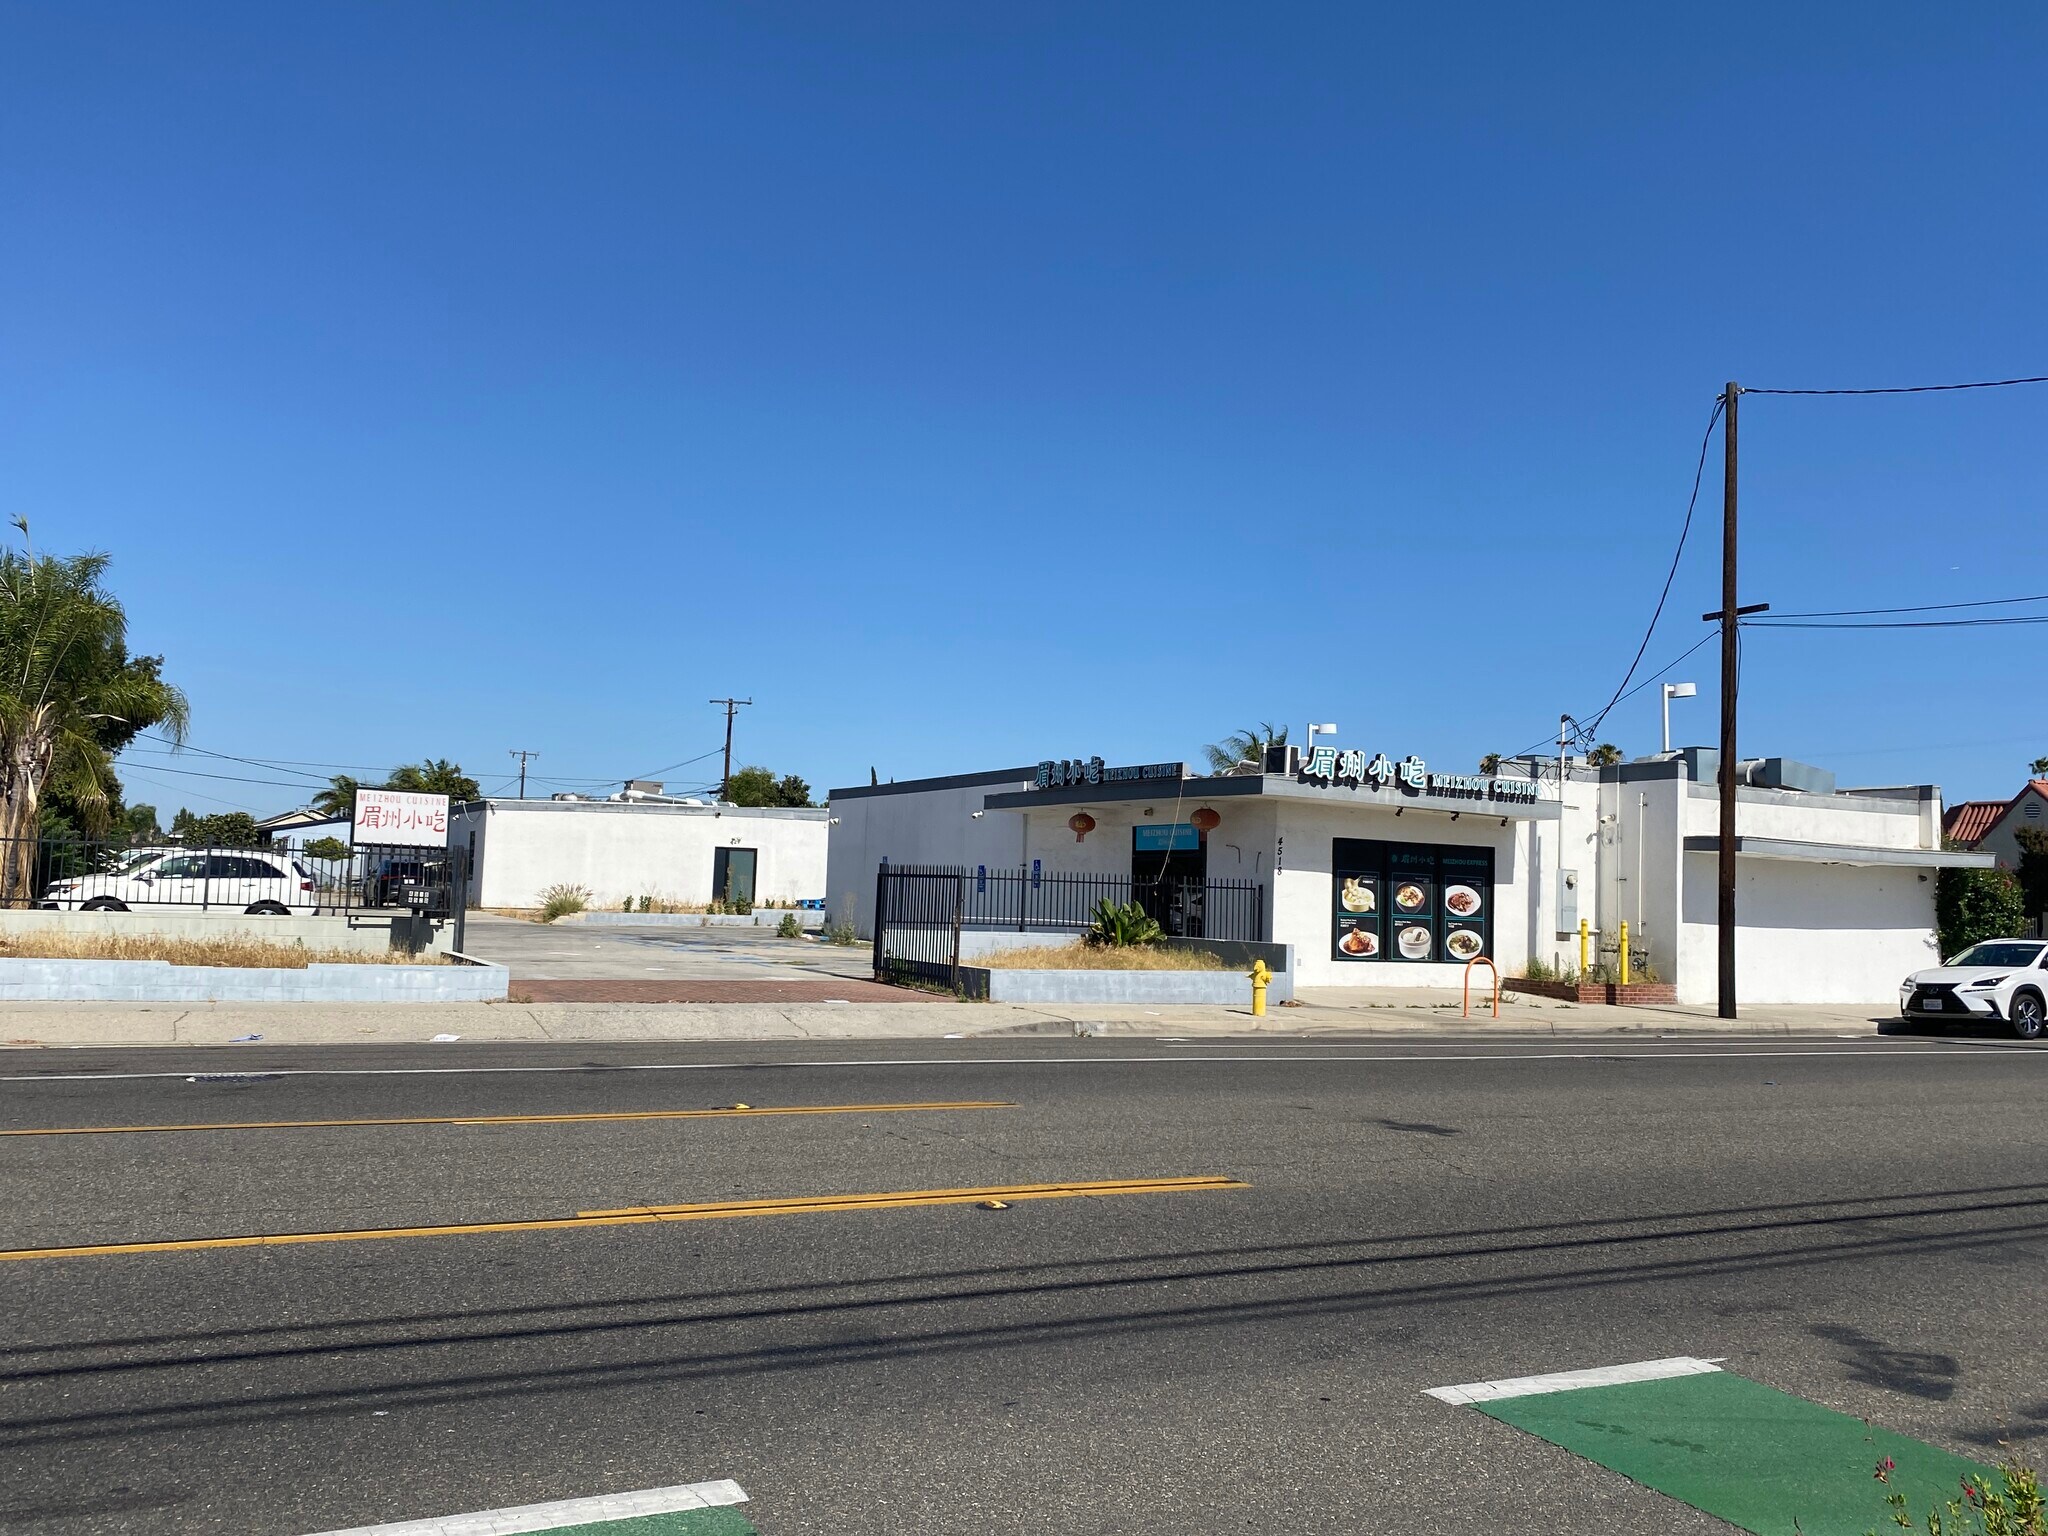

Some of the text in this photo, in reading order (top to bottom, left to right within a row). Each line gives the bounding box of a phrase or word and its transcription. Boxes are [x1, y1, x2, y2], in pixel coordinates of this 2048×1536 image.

[1034, 756, 1101, 788] 眉州小吃
[1103, 763, 1178, 781] MEIZHOU CUISINE
[1303, 746, 1425, 788] 眉州小吃
[1432, 774, 1489, 791] MEIZHOU
[359, 793, 447, 806] MEIZHOU CUISINE
[356, 805, 446, 832] 眉州小吃
[1442, 858, 1488, 867] MEIZHOU EXPRESS
